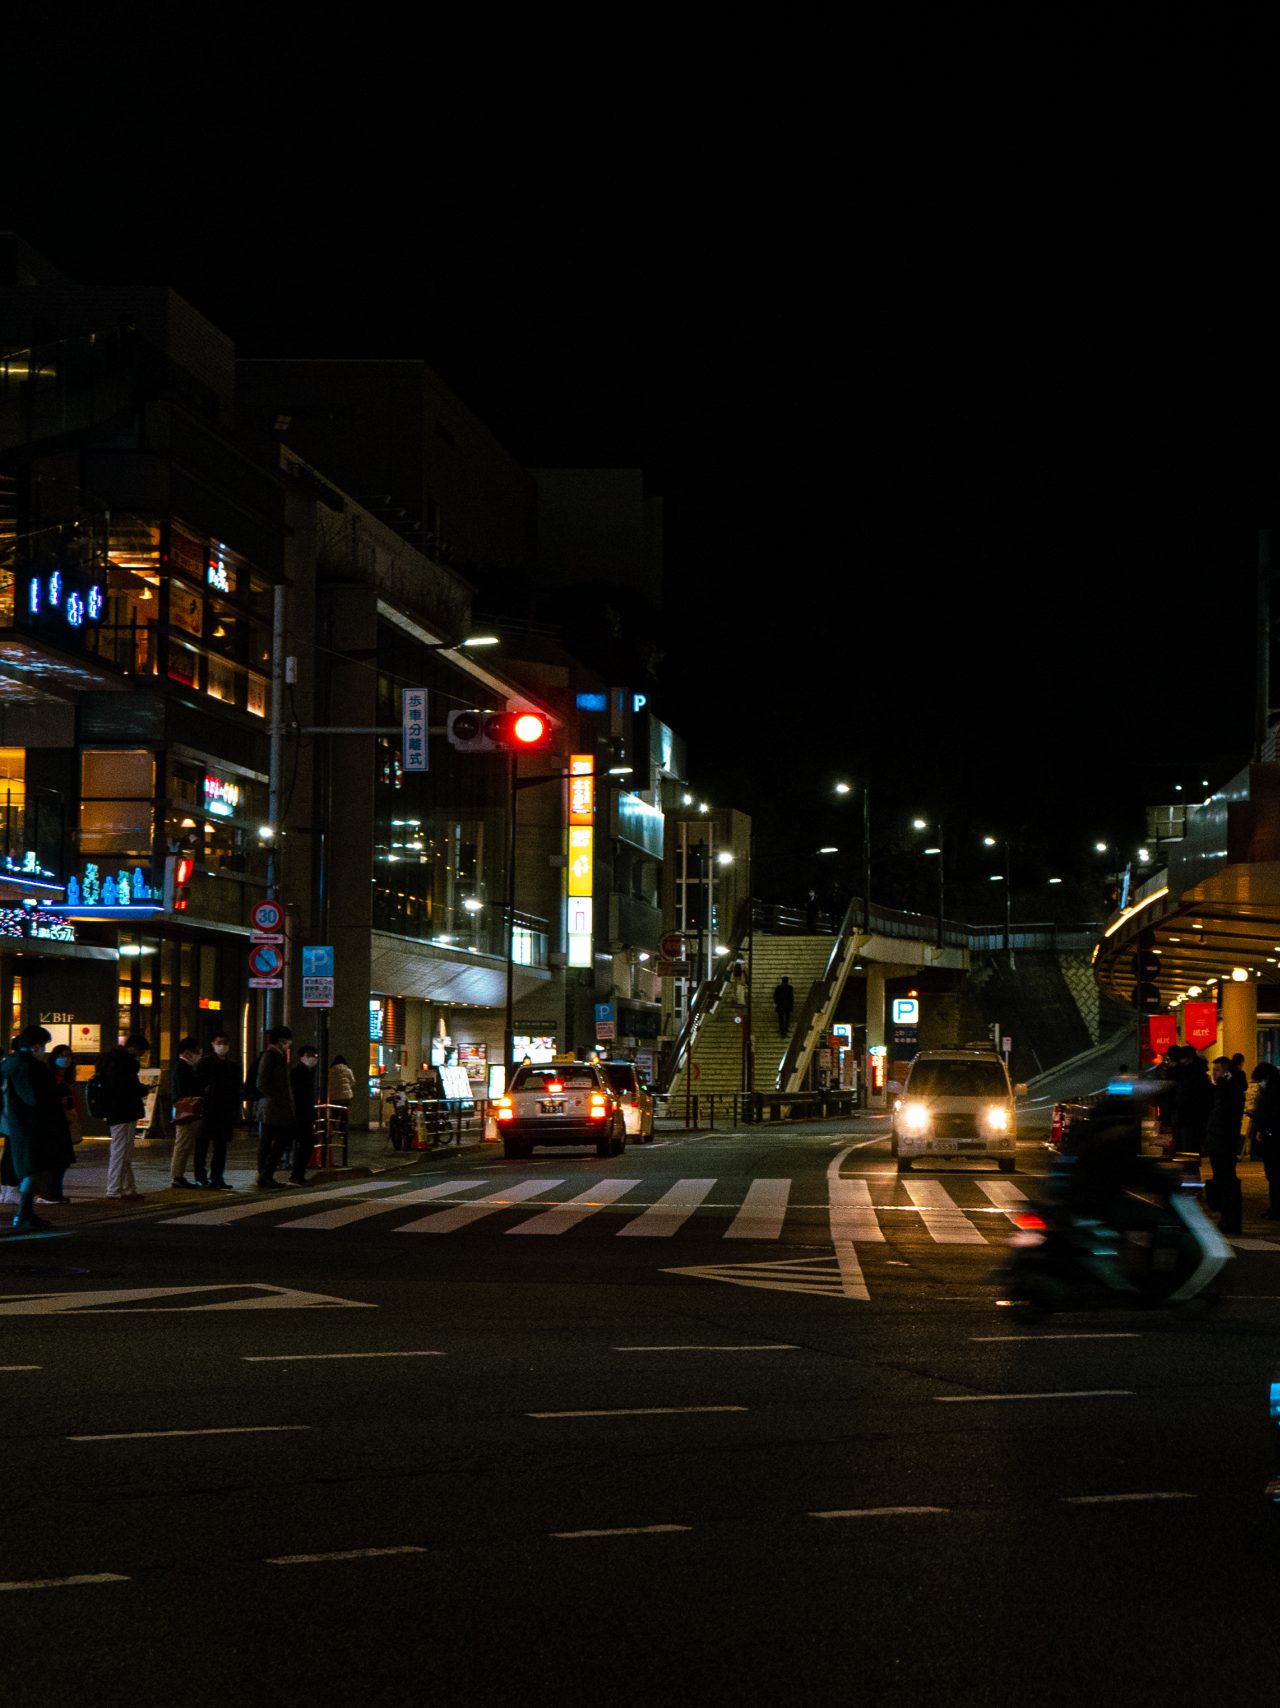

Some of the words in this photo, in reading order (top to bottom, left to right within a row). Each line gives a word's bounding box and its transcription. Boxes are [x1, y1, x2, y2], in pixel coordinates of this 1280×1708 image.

[633, 694, 647, 713] P
[408, 694, 424, 766] 歩車分離式
[258, 909, 277, 924] 30
[311, 949, 328, 973] P
[599, 1004, 610, 1019] P
[897, 1001, 915, 1020] P
